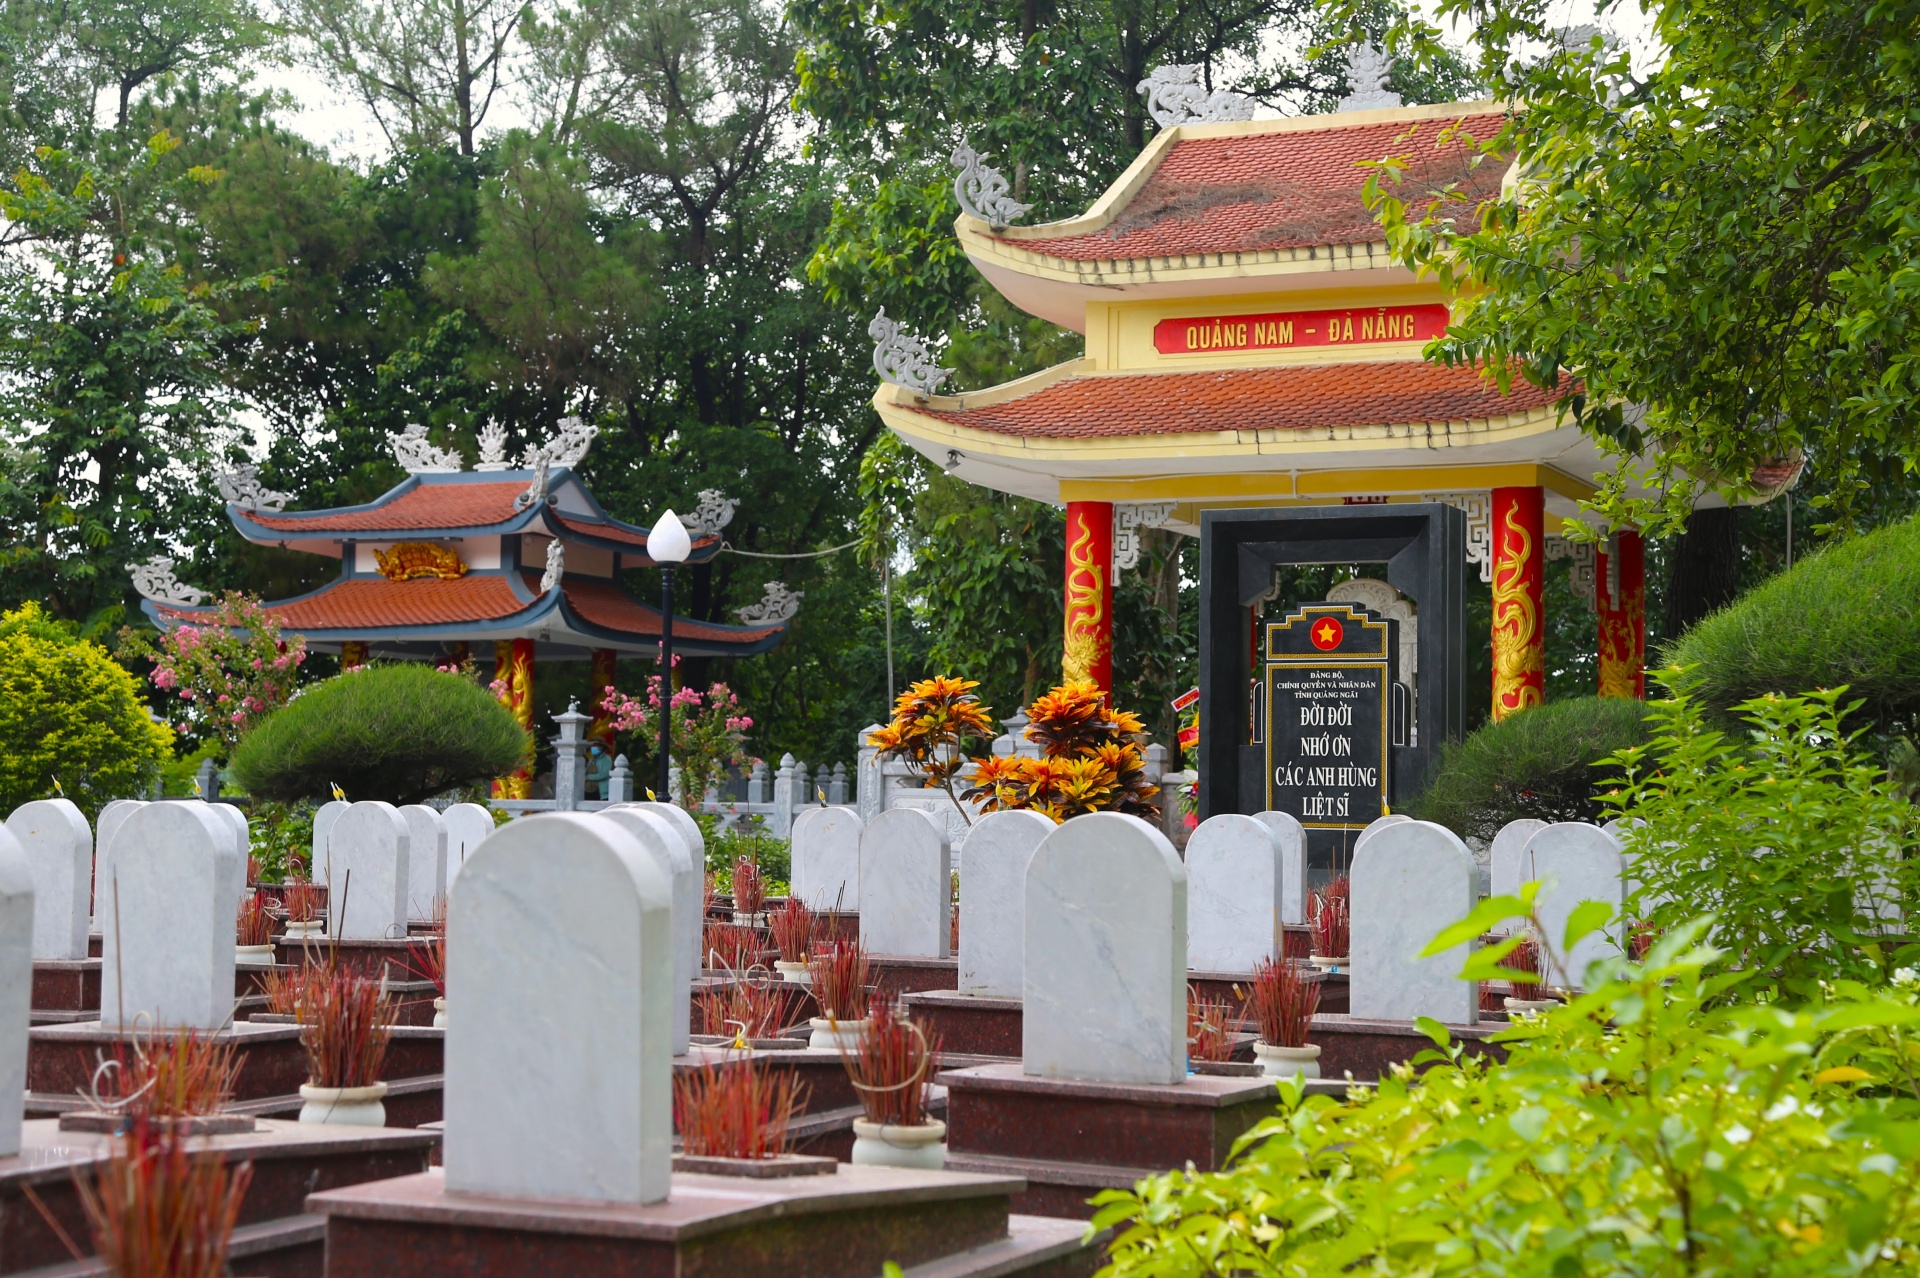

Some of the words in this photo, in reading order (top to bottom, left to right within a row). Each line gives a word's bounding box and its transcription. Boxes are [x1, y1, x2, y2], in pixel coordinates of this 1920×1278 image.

[1186, 319, 1247, 350] QUẢNG
[1254, 321, 1294, 345] NAM
[1328, 312, 1355, 342] ĐÀ
[1362, 307, 1415, 340] NẴNG
[1276, 681, 1300, 689] CHÍNH
[1301, 679, 1326, 689] QUYỀN
[1338, 680, 1359, 688] NHÂN
[1360, 680, 1376, 689] DÂN
[1310, 670, 1331, 679] ĐẢNG
[1332, 670, 1345, 680] BỘ,
[1294, 690, 1312, 699] TỈNH
[1312, 690, 1339, 699] QUẢNG
[1340, 690, 1359, 699] NGÃI
[1300, 700, 1325, 726] ĐỜI
[1327, 700, 1353, 726] ĐỜI
[1300, 731, 1330, 757] NHỚ
[1332, 734, 1351, 757] ƠN
[1275, 760, 1304, 786] CÁC
[1306, 766, 1335, 787] ANH
[1337, 761, 1378, 787] HÙNG
[1302, 791, 1335, 820] LIỆT
[1336, 792, 1350, 817] SĨ
